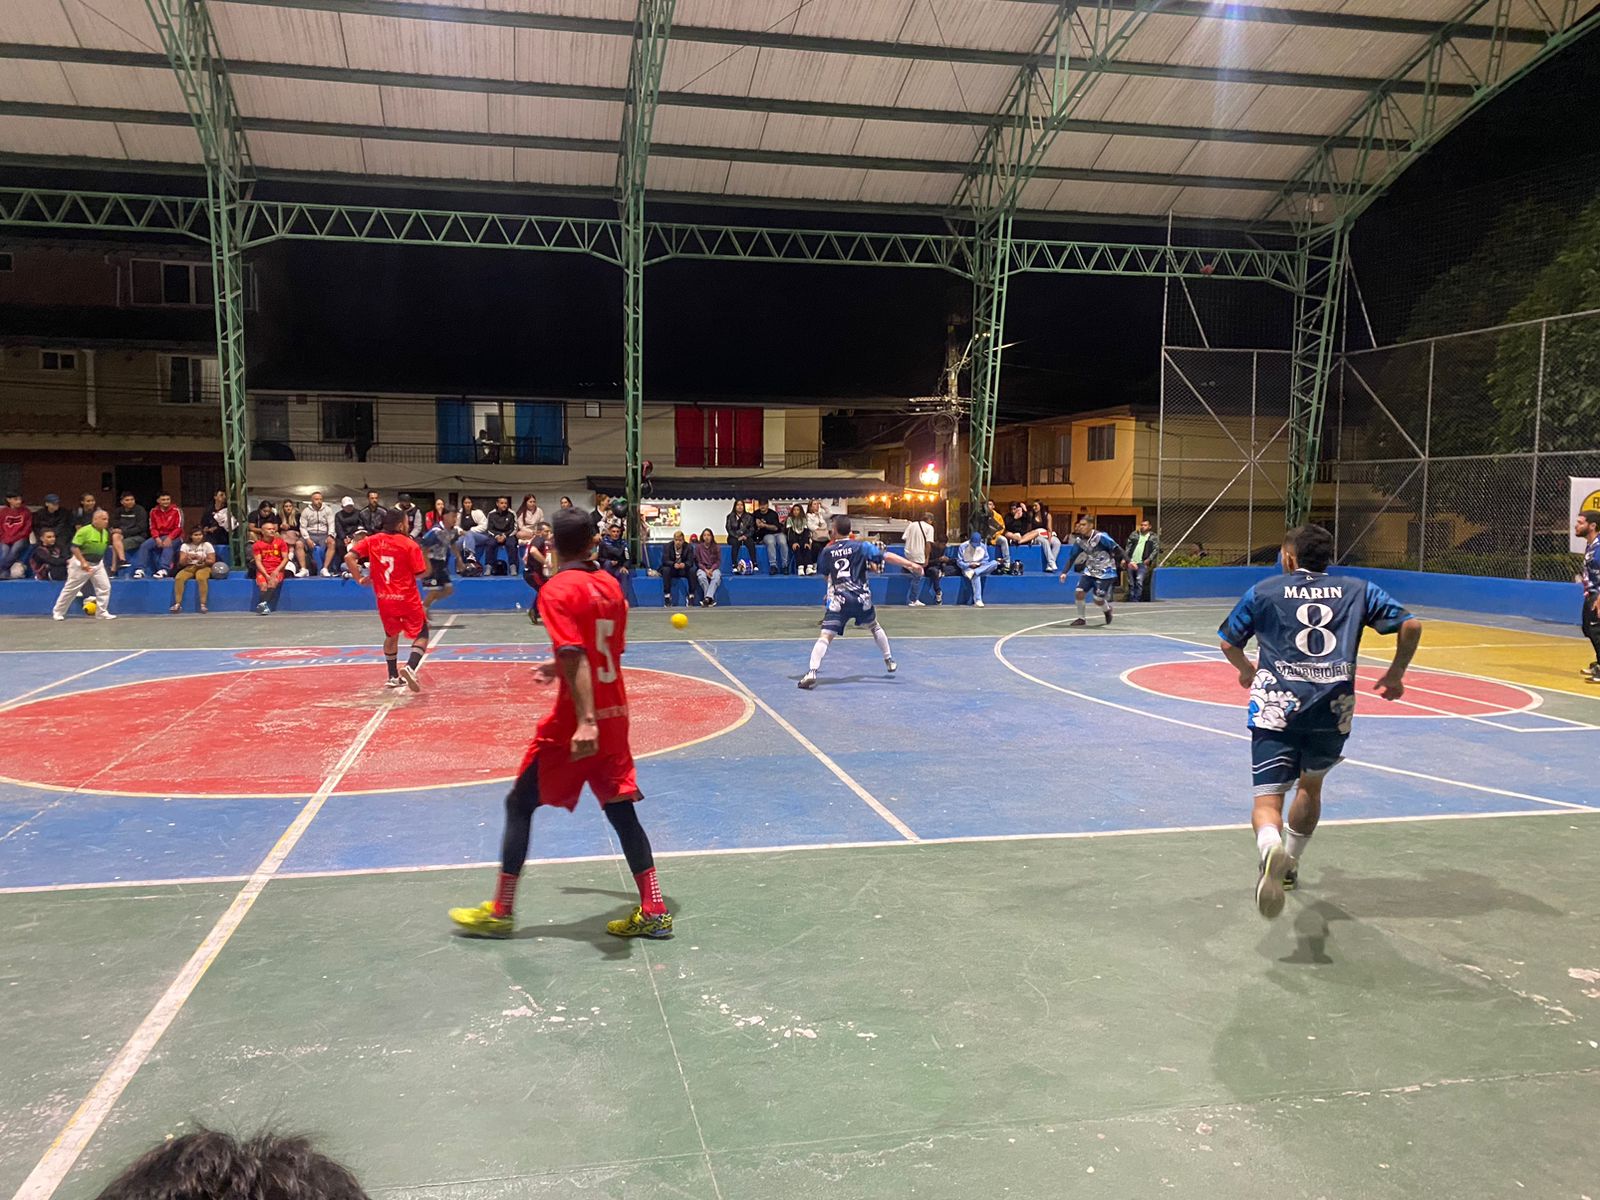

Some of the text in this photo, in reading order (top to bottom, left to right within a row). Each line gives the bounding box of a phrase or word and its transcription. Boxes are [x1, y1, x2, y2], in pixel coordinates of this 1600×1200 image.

[830, 547, 853, 558] TATUS
[380, 555, 395, 585] 7
[834, 558, 851, 579] 2
[1283, 586, 1343, 599] MARIN
[1295, 603, 1337, 657] 8
[595, 618, 617, 684] 5
